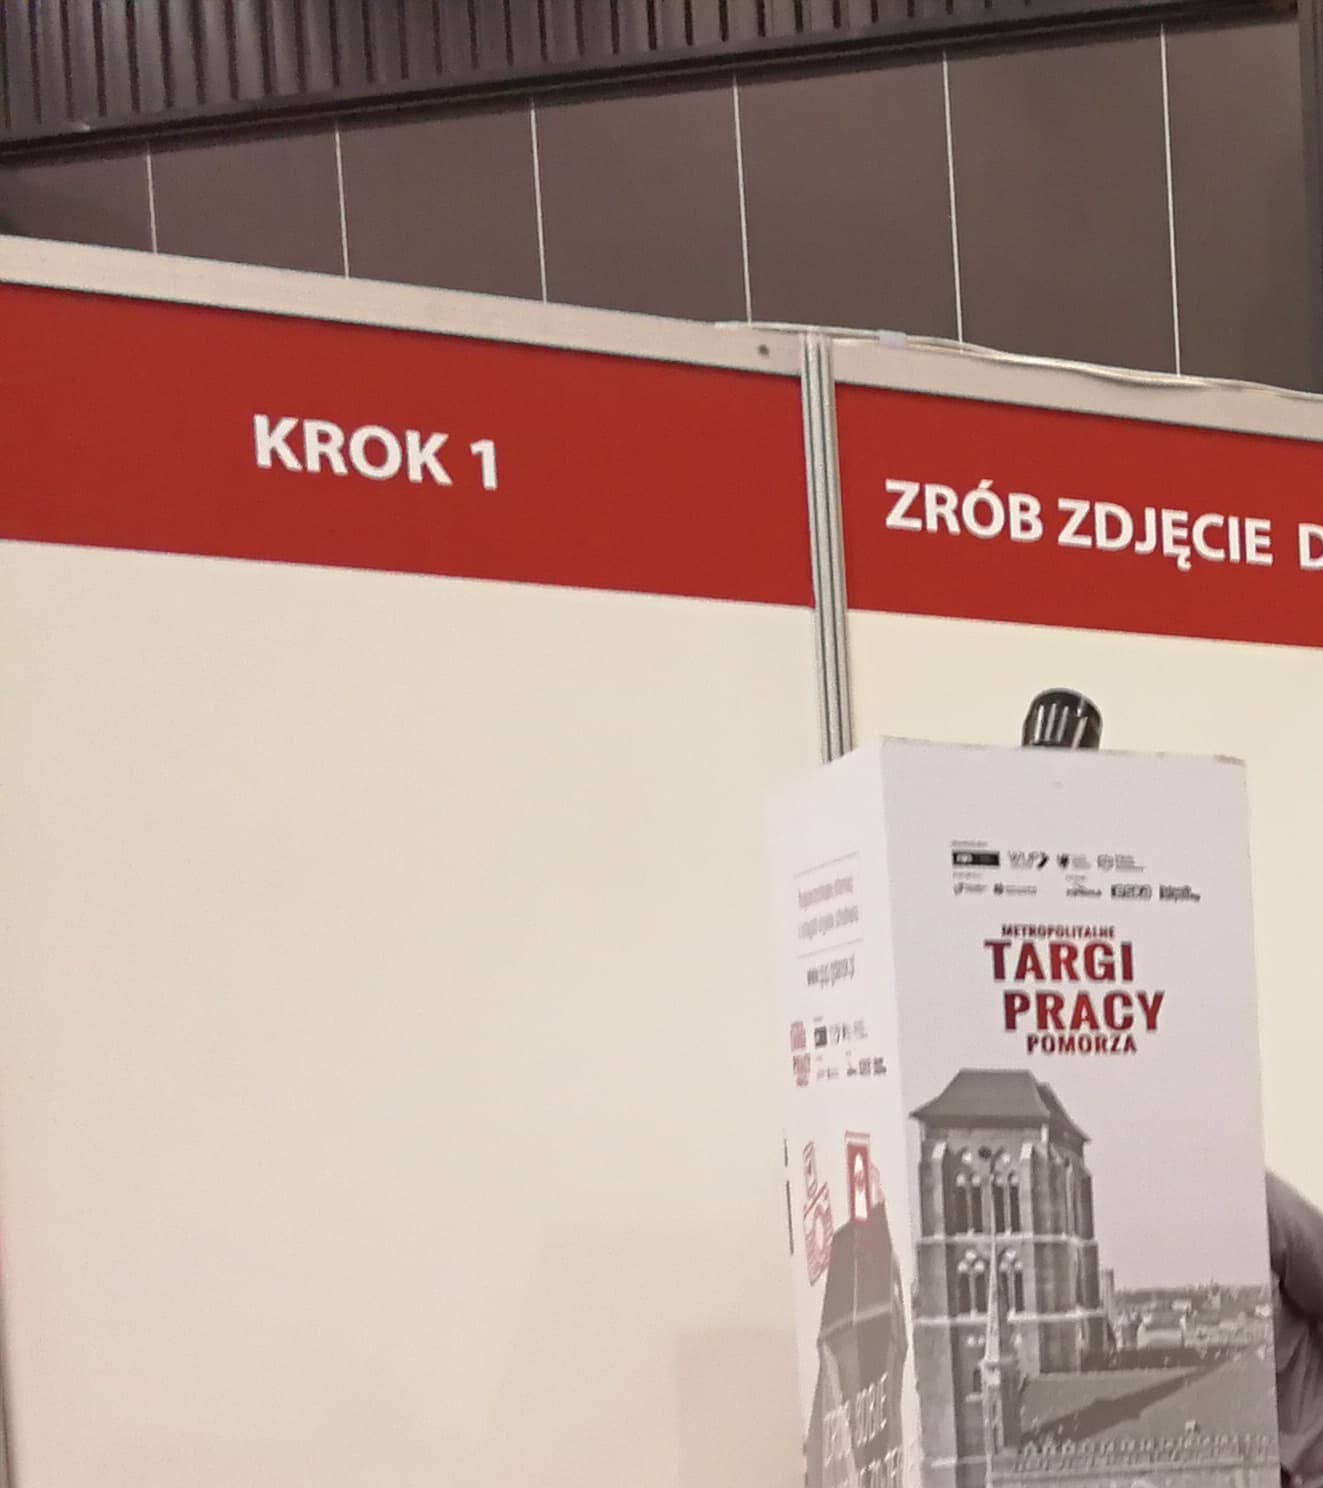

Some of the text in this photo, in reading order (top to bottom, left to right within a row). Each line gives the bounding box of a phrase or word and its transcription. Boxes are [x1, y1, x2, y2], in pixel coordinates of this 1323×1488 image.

[252, 413, 498, 491] KROK 1
[884, 478, 1044, 543] ZRÓB
[1057, 496, 1275, 572] ZDJĘCIE
[1001, 924, 1115, 939] METROPOLITALNE
[983, 939, 1134, 984] TARGI
[1003, 989, 1165, 1033] PRACY
[1026, 1033, 1138, 1055] POMORZA
